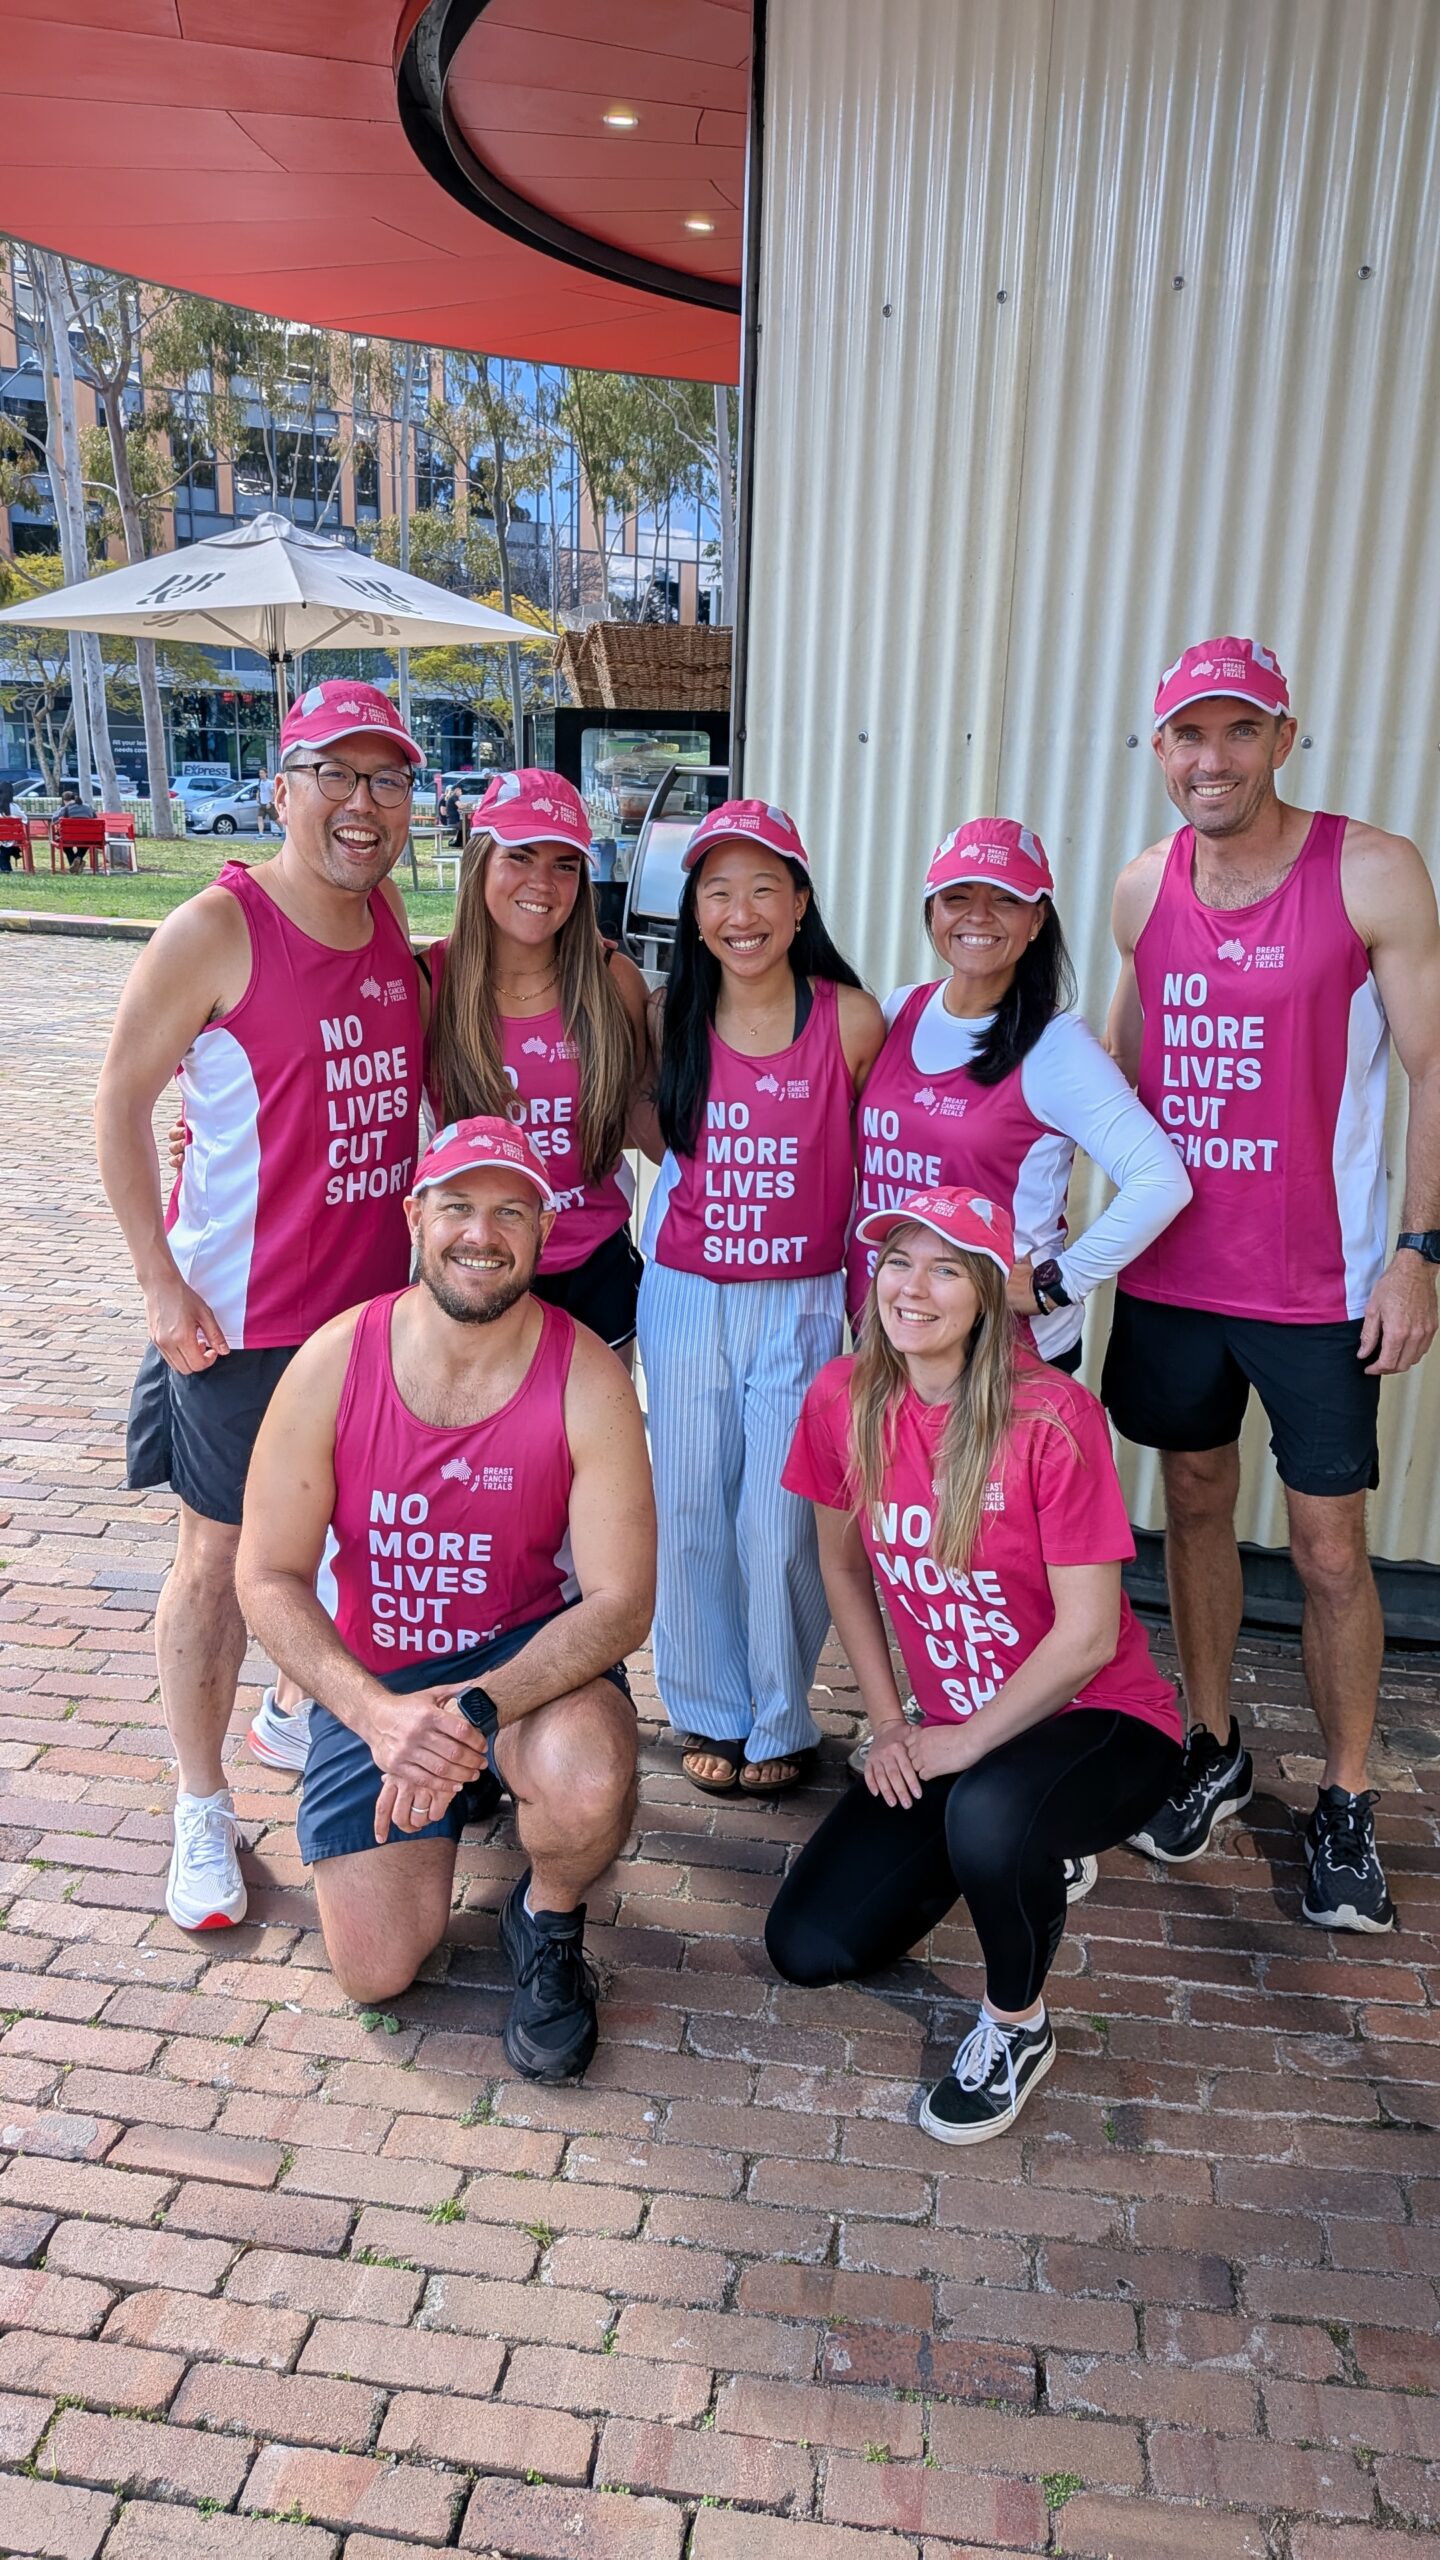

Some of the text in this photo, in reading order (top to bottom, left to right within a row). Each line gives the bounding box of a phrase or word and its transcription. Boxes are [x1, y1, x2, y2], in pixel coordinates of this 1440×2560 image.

[1255, 953, 1284, 961] CANCER
[1163, 973, 1207, 1007] NO
[320, 1015, 363, 1052] NO
[1163, 1014, 1264, 1049] MORE
[326, 1046, 408, 1092] MORE
[1163, 1054, 1261, 1091] LIVES
[328, 1086, 408, 1131] LIVES
[505, 1097, 572, 1126] ORE
[707, 1102, 749, 1130] NO
[940, 1108, 964, 1117] TRIALS
[941, 1102, 966, 1110] CANCER
[943, 1096, 968, 1104] BREAST
[1162, 1094, 1226, 1130] CUT
[864, 1107, 899, 1141] NO
[328, 1130, 387, 1169] CUT
[707, 1136, 798, 1165] MORE
[864, 1145, 941, 1187] MORE
[326, 1157, 411, 1205] SHORT
[706, 1170, 795, 1198] LIVES
[863, 1180, 920, 1211] LIV
[705, 1203, 767, 1232] CUT
[703, 1236, 807, 1265] SHORT
[483, 1467, 514, 1475] BREAST
[483, 1482, 513, 1490] TRIALS
[369, 1490, 429, 1525] NO
[872, 1501, 931, 1548] NO
[369, 1529, 492, 1562] MORE
[371, 1561, 487, 1594] LIVES
[876, 1552, 1007, 1606] MORE
[372, 1592, 451, 1624] CUT
[372, 1622, 502, 1653] SHORT
